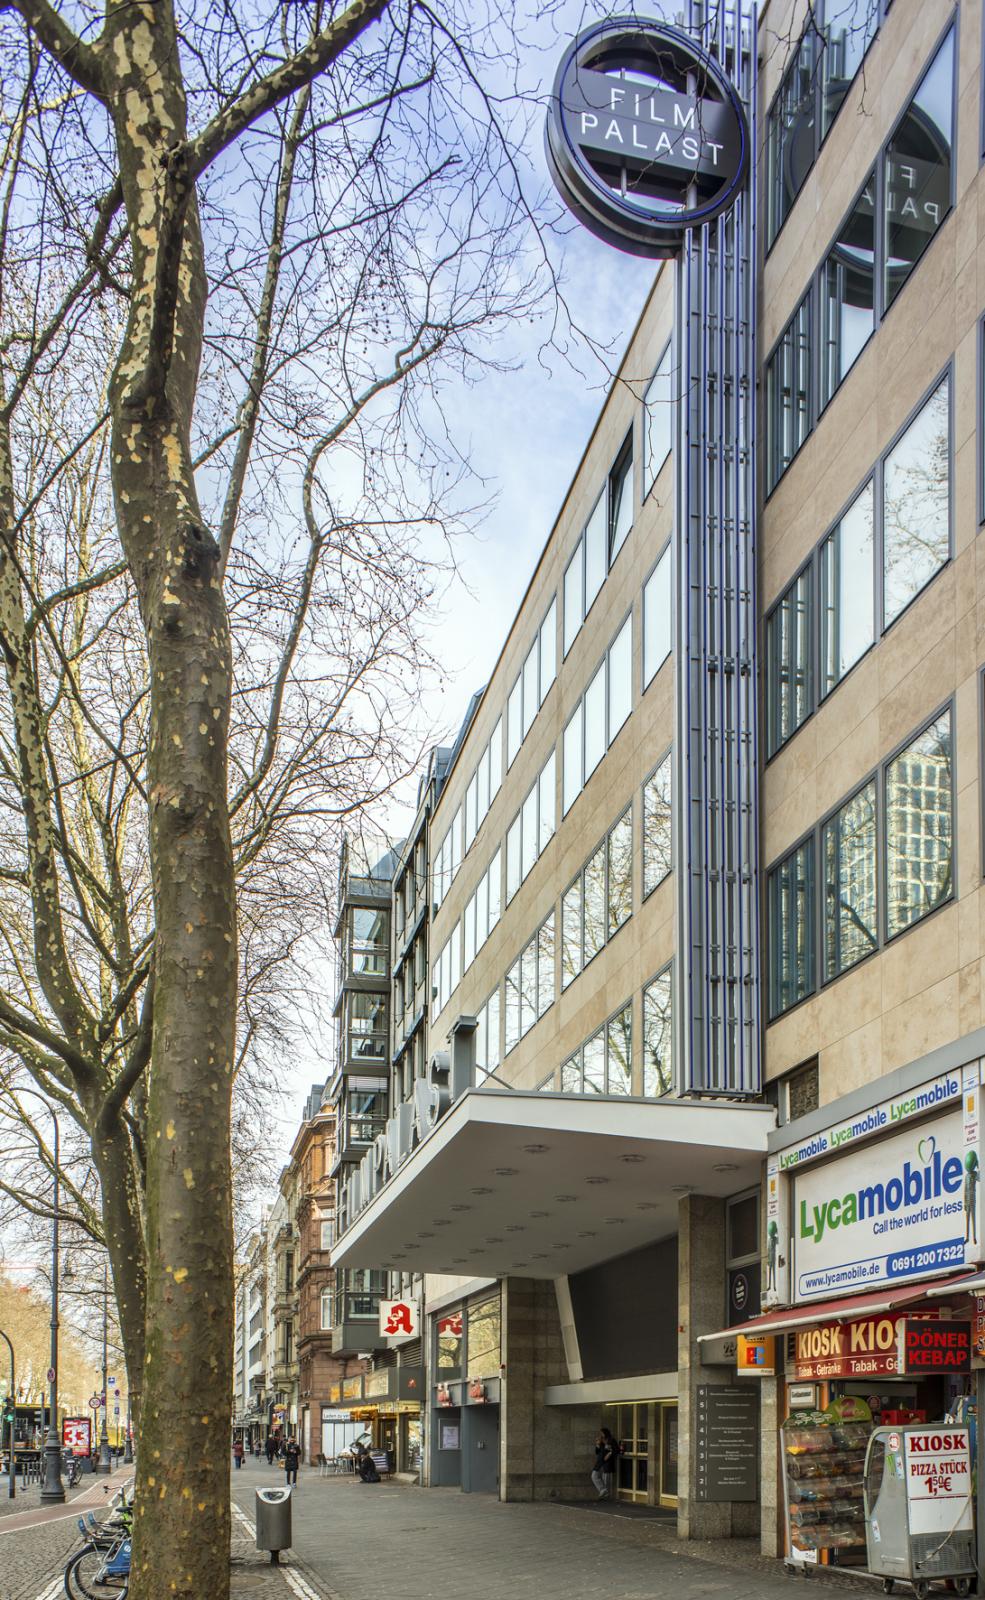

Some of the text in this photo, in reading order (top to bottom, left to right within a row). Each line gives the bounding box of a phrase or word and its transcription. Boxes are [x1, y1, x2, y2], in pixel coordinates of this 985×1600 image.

[610, 87, 695, 130] FILM
[581, 112, 724, 166] PALAST
[780, 1079, 958, 1168] Lycamobile Lycamobile Lycamobile
[800, 1151, 963, 1243] Lycamobile
[873, 1201, 963, 1235] Call the world for less
[805, 1262, 880, 1289] www.lycamobile.de
[798, 1326, 841, 1359] KIOSK
[907, 1328, 969, 1347] DÖNER
[798, 1366, 813, 1377] Tabak
[816, 1363, 842, 1375] Getränke
[851, 1359, 878, 1372] Tabak
[908, 1350, 968, 1365] KEBAP
[910, 1434, 967, 1452] KIOSK
[911, 1459, 968, 1476] PIZZA STÜCK
